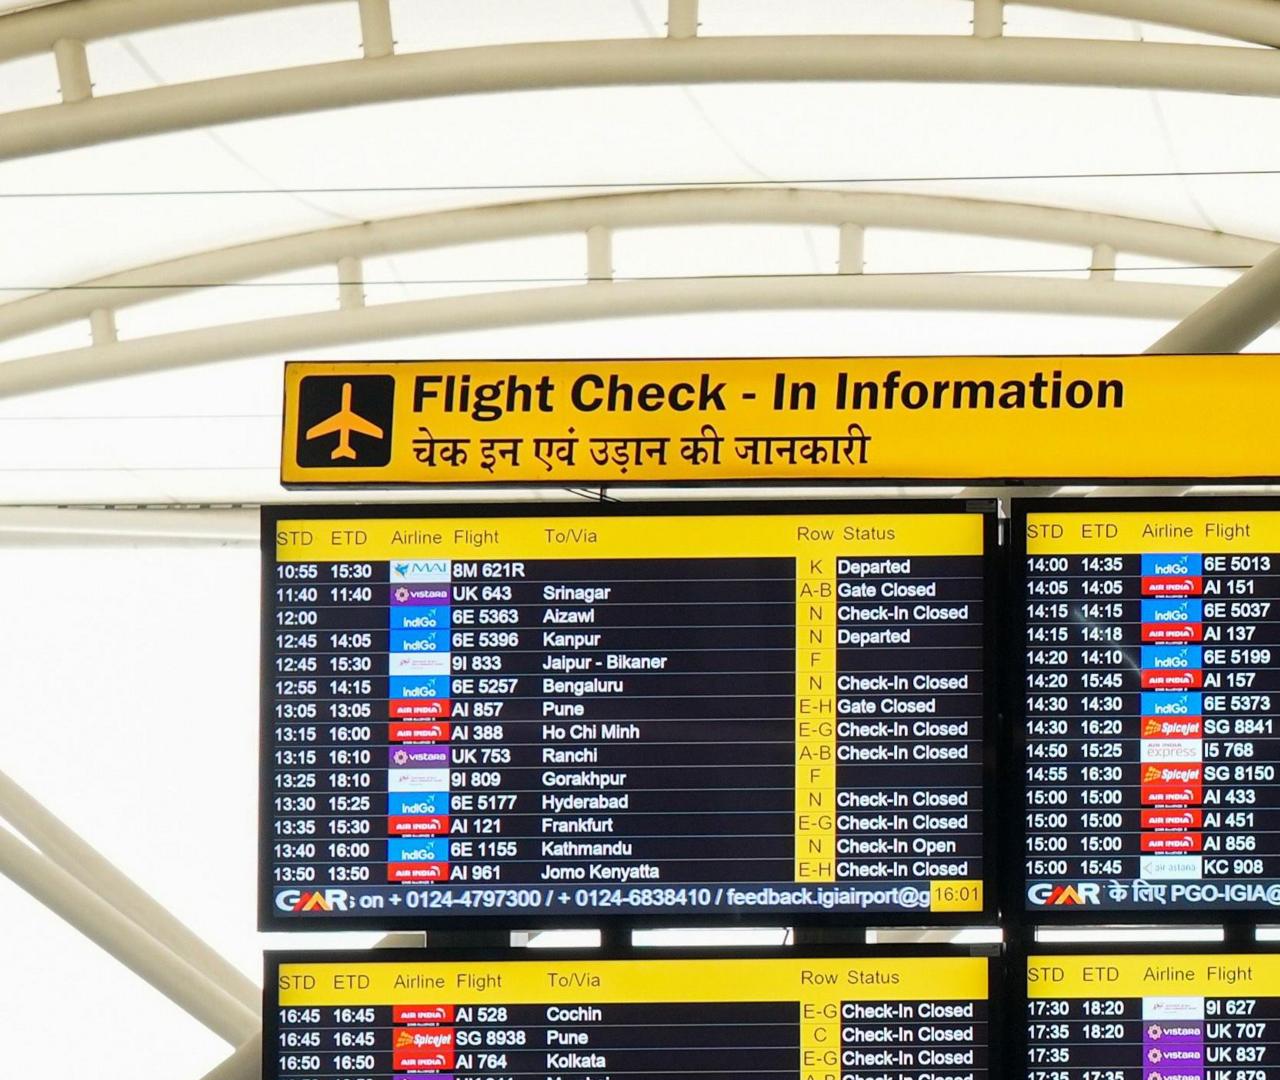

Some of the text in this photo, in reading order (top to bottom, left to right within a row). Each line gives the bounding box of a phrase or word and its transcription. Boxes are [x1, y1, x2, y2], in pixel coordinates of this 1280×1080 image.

[414, 371, 1124, 421] Flight Check In Information
[413, 424, 871, 473] चेक इन एवं उड़ान की जानकारी
[276, 526, 895, 547] STD ETD Airline Flight To/Via Row Status
[277, 582, 935, 603] 11:40 11:40 UK 643 Srinagar A-B Gate Closed
[1027, 674, 1067, 687] 14:20
[1082, 674, 1122, 687] 15:45
[1204, 673, 1220, 687] AI
[1227, 673, 1255, 687] 157
[1028, 1001, 1069, 1015] 17:30
[1083, 1001, 1124, 1015] 18:20
[1226, 1000, 1255, 1014] 627
[280, 1027, 973, 1046] 16:45 16:45 SG 8938 Pune C Check-In Closed
